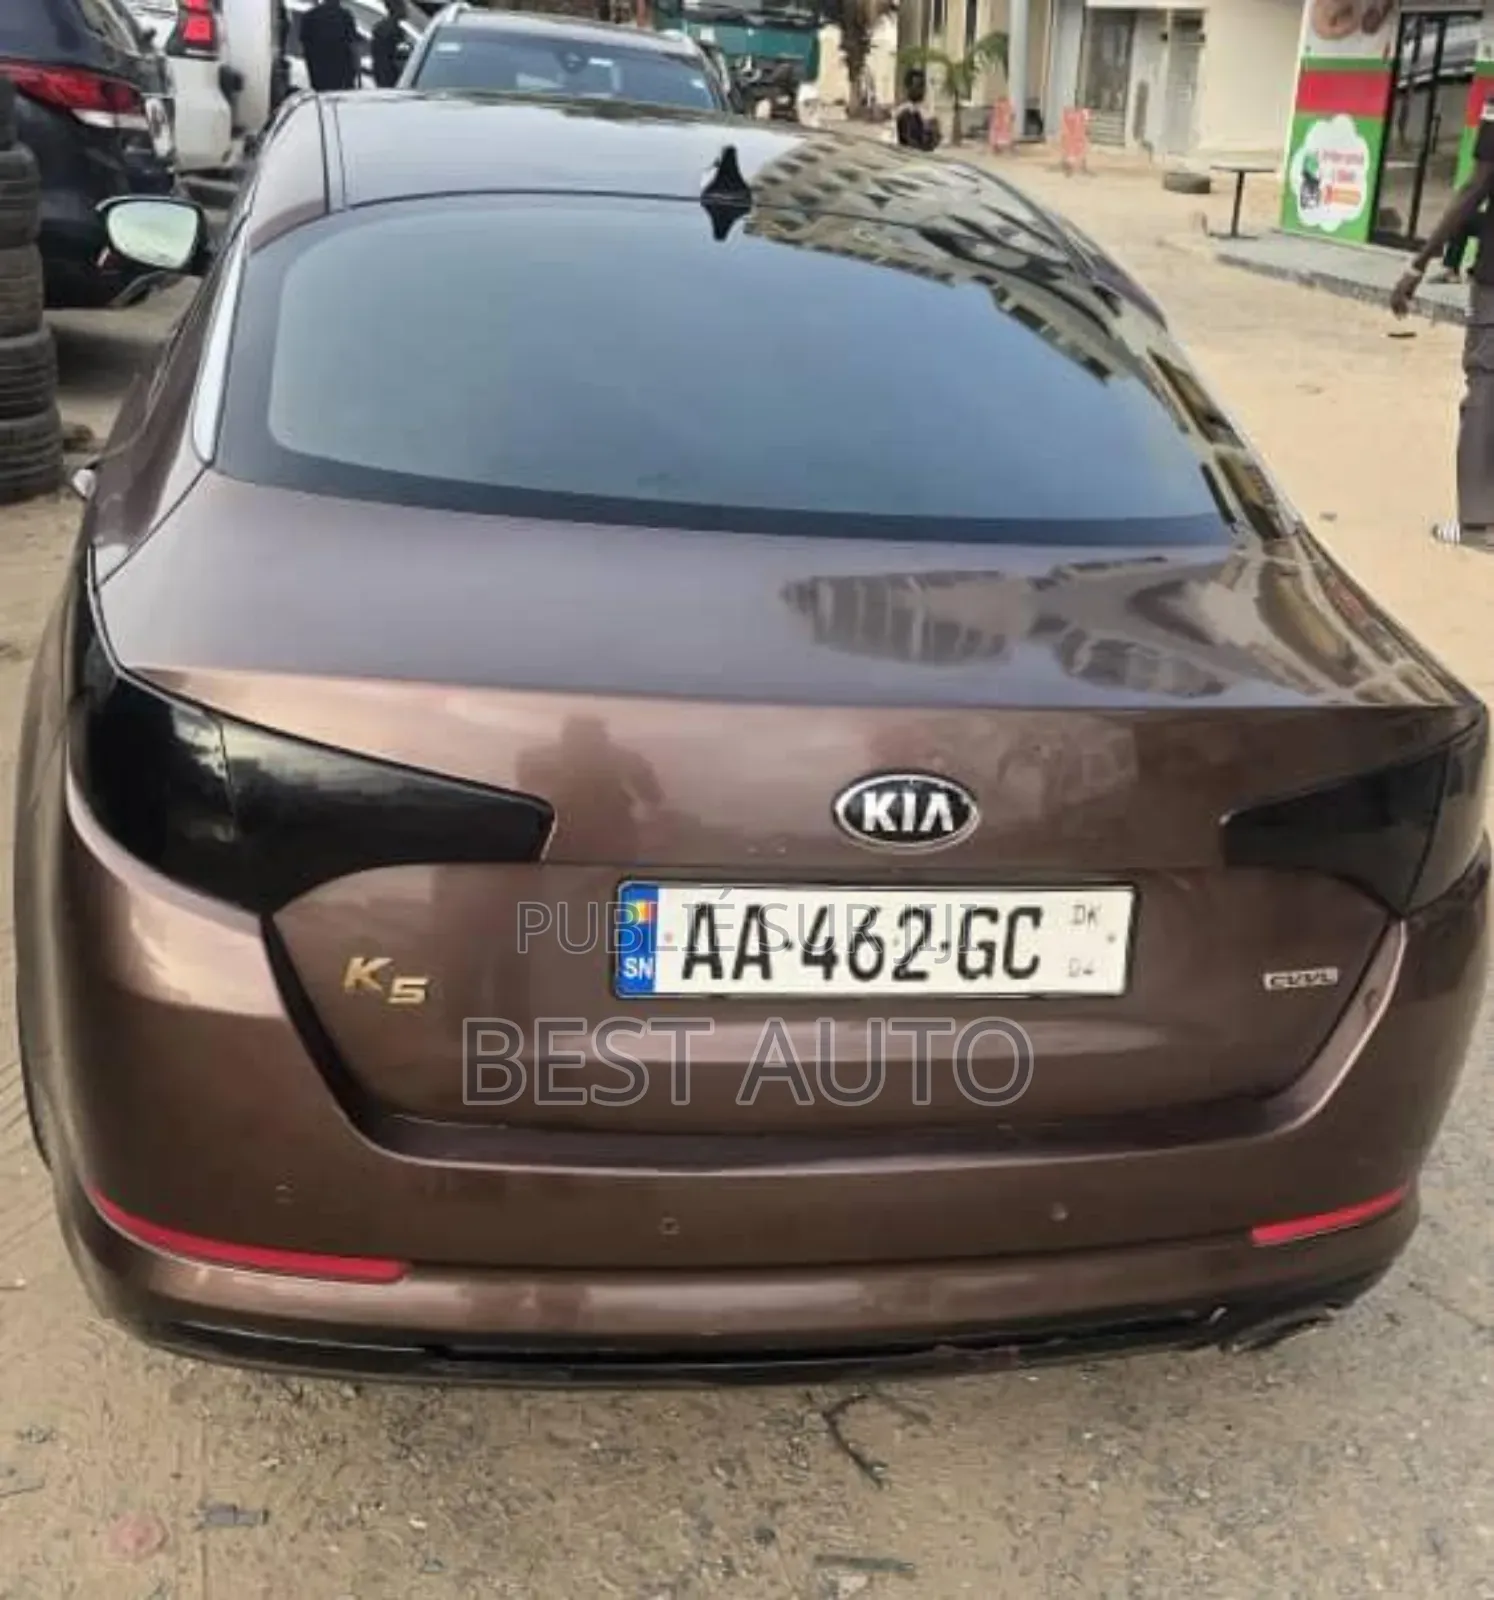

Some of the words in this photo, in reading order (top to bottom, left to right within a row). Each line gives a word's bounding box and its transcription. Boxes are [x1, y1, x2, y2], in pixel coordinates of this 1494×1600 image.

[862, 791, 954, 832] KIA
[343, 956, 430, 1004] K5
[622, 957, 656, 980] SN
